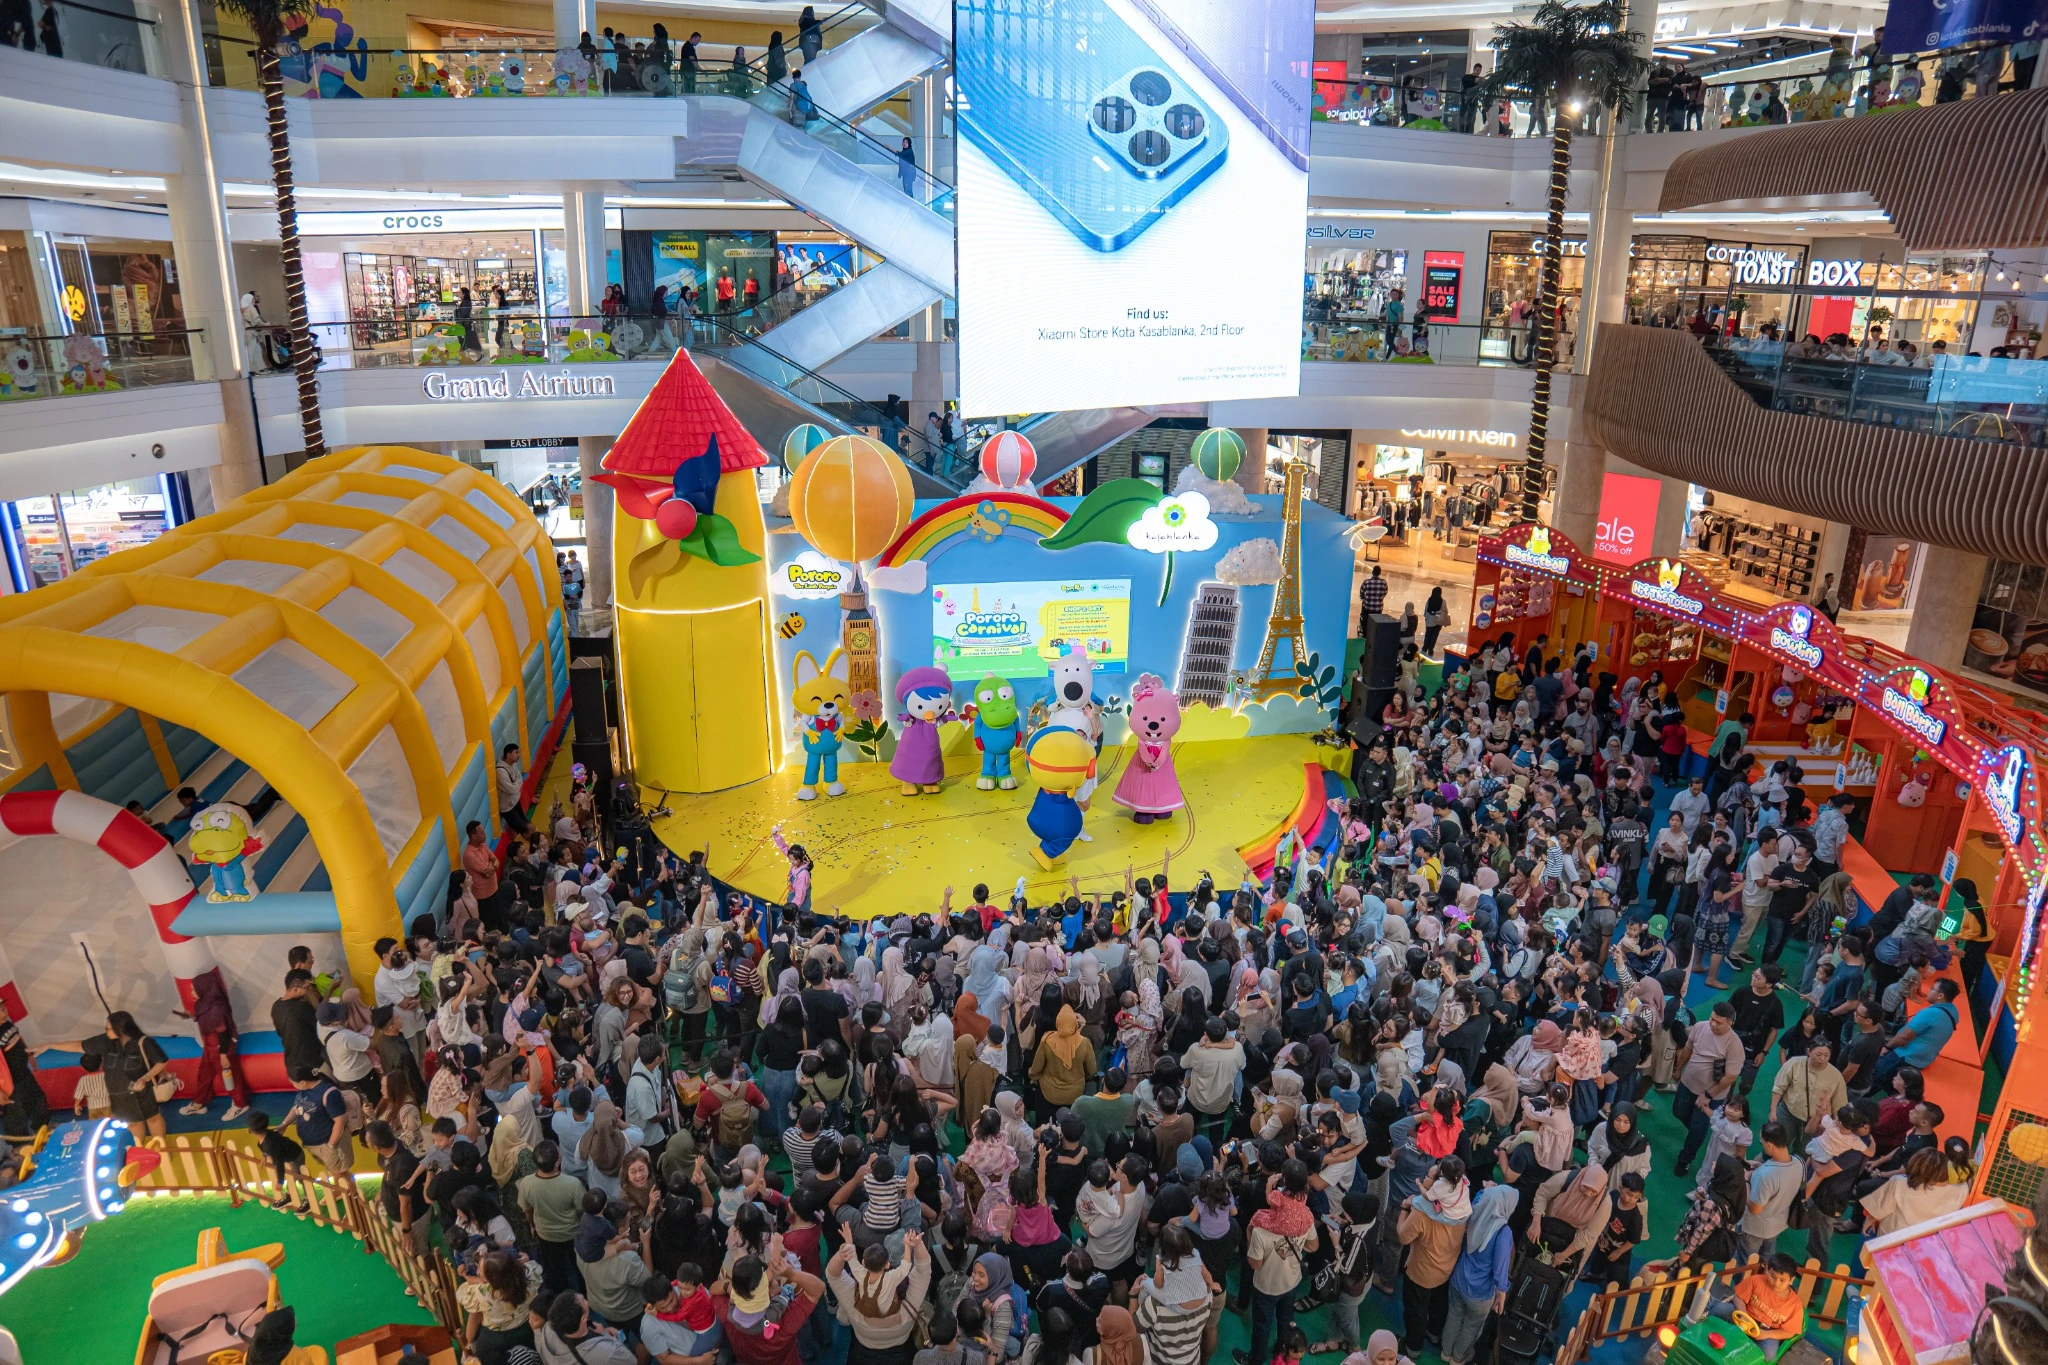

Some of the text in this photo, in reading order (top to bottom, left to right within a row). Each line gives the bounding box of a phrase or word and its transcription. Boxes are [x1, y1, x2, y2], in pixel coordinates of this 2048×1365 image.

[1939, 23, 2012, 42] kotakasablanka
[383, 215, 443, 229] crocs
[1734, 259, 1864, 286] TOAST BOX
[1428, 285, 1455, 296] SALE
[1428, 295, 1455, 307] 50%
[1127, 308, 1169, 319] Find us:
[1038, 323, 1245, 340] Xiaomi Store Kota Kasablanka, 2nd Floor
[422, 369, 616, 400] Grand Atrium
[510, 438, 564, 448] EAST LOBBY
[1595, 517, 1635, 545] ale
[1599, 542, 1618, 554] 50%
[1620, 547, 1633, 556] off
[1506, 545, 1569, 574] Basketball
[788, 564, 841, 583] Pororo
[1632, 580, 1702, 614] Hit The Tower
[964, 611, 1021, 625] Pororo
[956, 620, 1027, 637] Carnival
[1772, 628, 1823, 668] Bowling
[1882, 687, 1945, 743] Ball Barrel
